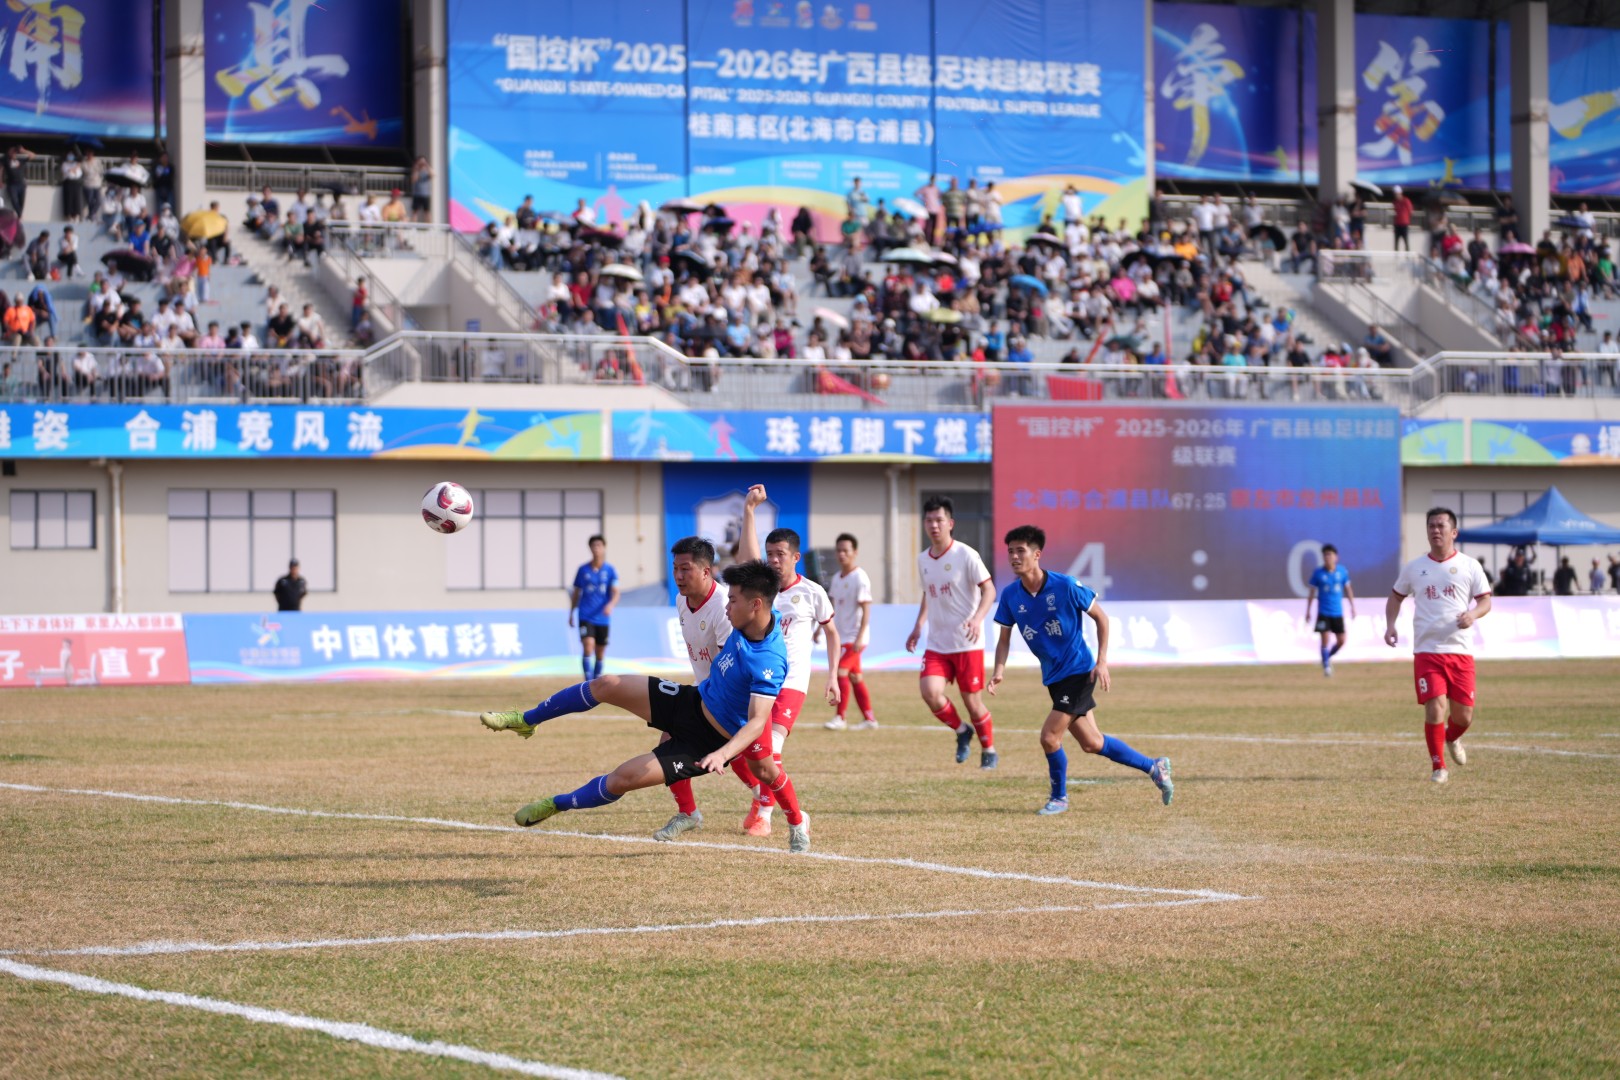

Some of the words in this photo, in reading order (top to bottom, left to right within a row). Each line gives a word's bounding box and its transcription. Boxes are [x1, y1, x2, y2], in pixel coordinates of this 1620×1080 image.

[1172, 446, 1237, 466] 级联赛
[1065, 542, 1113, 600] 4
[311, 623, 522, 660] 中国体育彩票
[1022, 620, 1063, 641] 合浦
